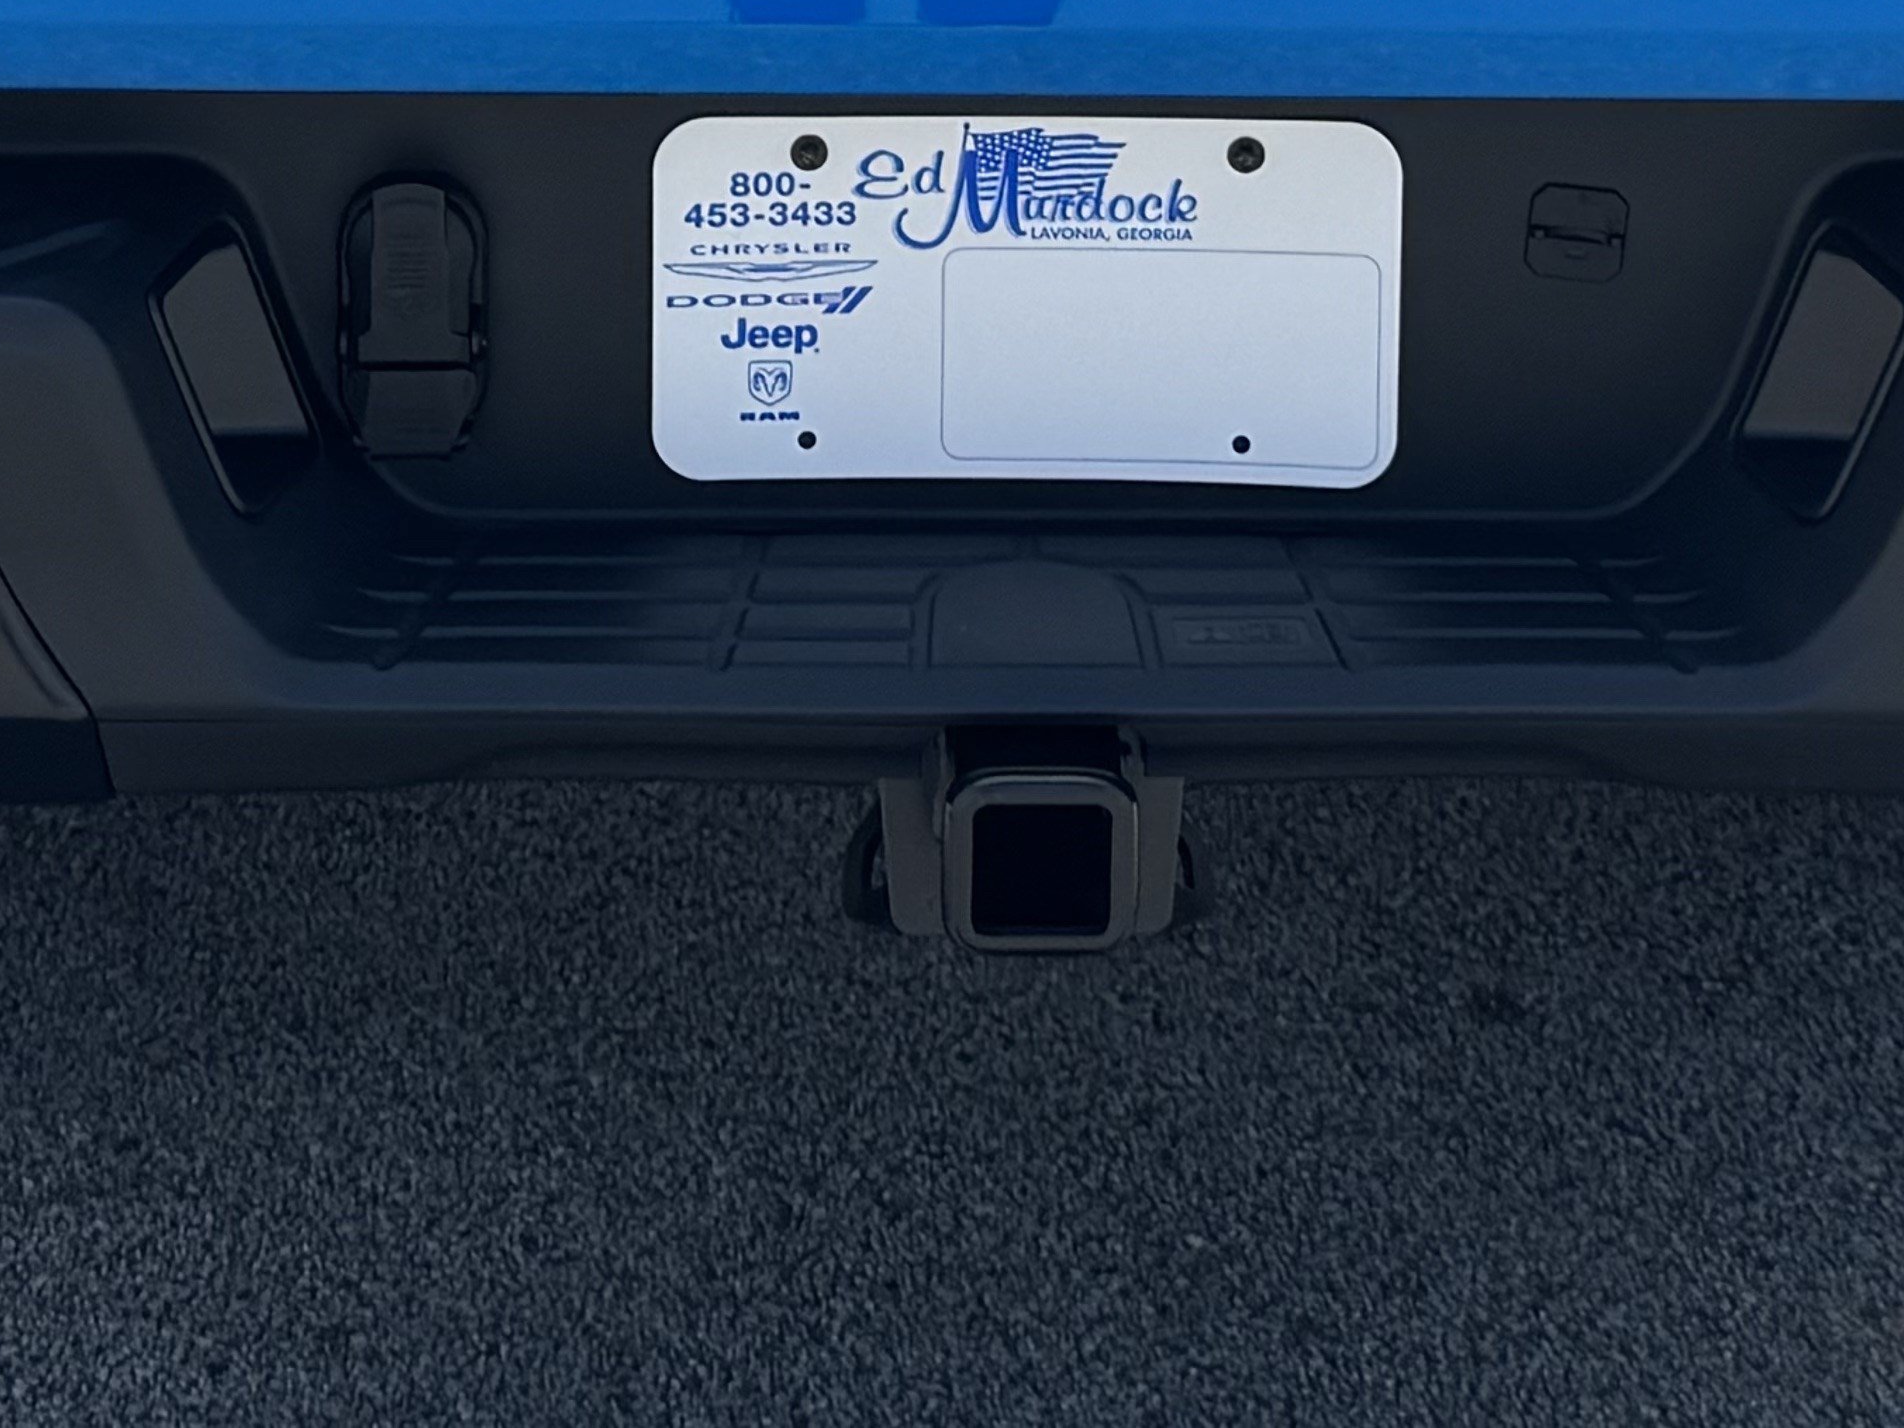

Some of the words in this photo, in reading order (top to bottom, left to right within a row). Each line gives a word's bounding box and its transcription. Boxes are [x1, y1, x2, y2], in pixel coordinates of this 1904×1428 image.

[729, 171, 812, 197] 800-
[851, 149, 946, 201] Ed
[893, 147, 1199, 250] Murdock
[684, 201, 856, 228] 453-3433
[1030, 227, 1111, 241] LAVONIA,
[1116, 227, 1193, 242] GEORGIA
[689, 242, 852, 256] CHRYSLER
[665, 289, 851, 311] DODGE
[720, 317, 819, 354] Jeep
[739, 410, 801, 422] RAM
